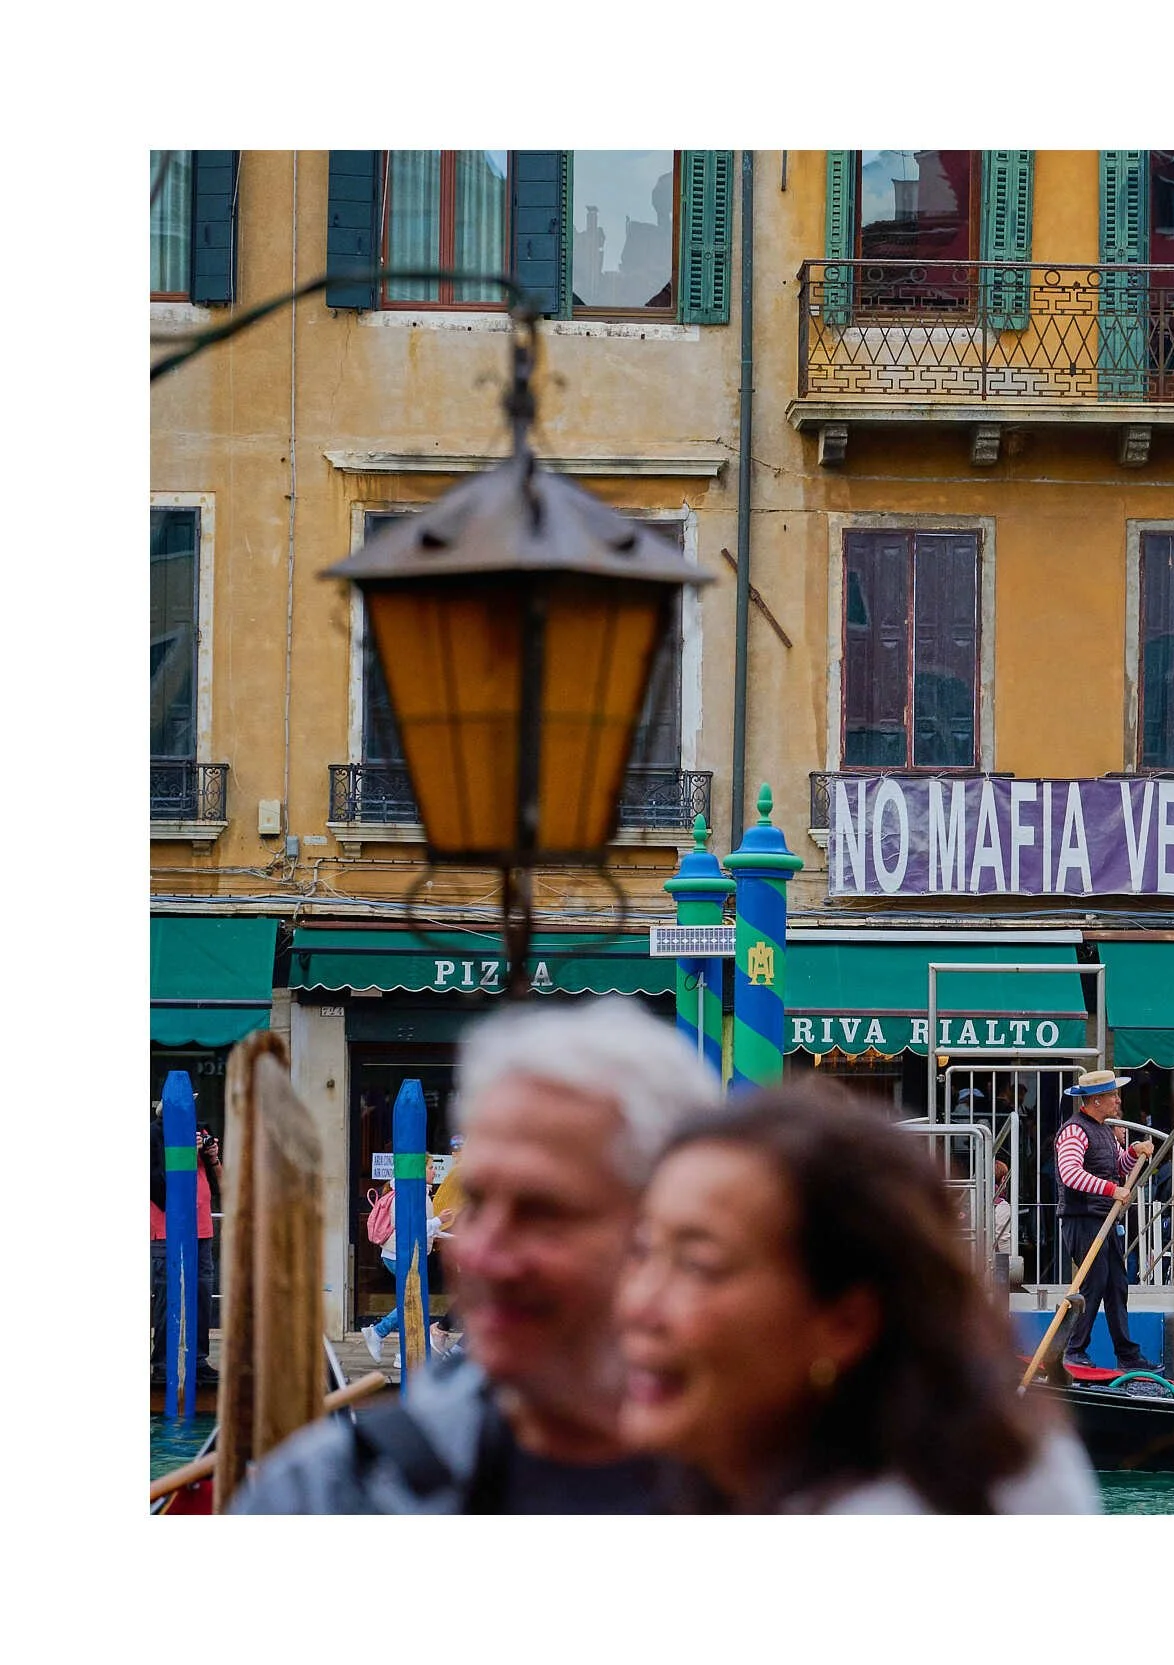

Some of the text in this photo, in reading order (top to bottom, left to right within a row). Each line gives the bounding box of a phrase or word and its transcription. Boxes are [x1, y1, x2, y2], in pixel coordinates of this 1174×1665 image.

[836, 779, 909, 892] NO
[929, 780, 1093, 892] MAFIA
[434, 960, 553, 986] PIZA
[791, 1018, 1059, 1047] RIVA RIALTO
